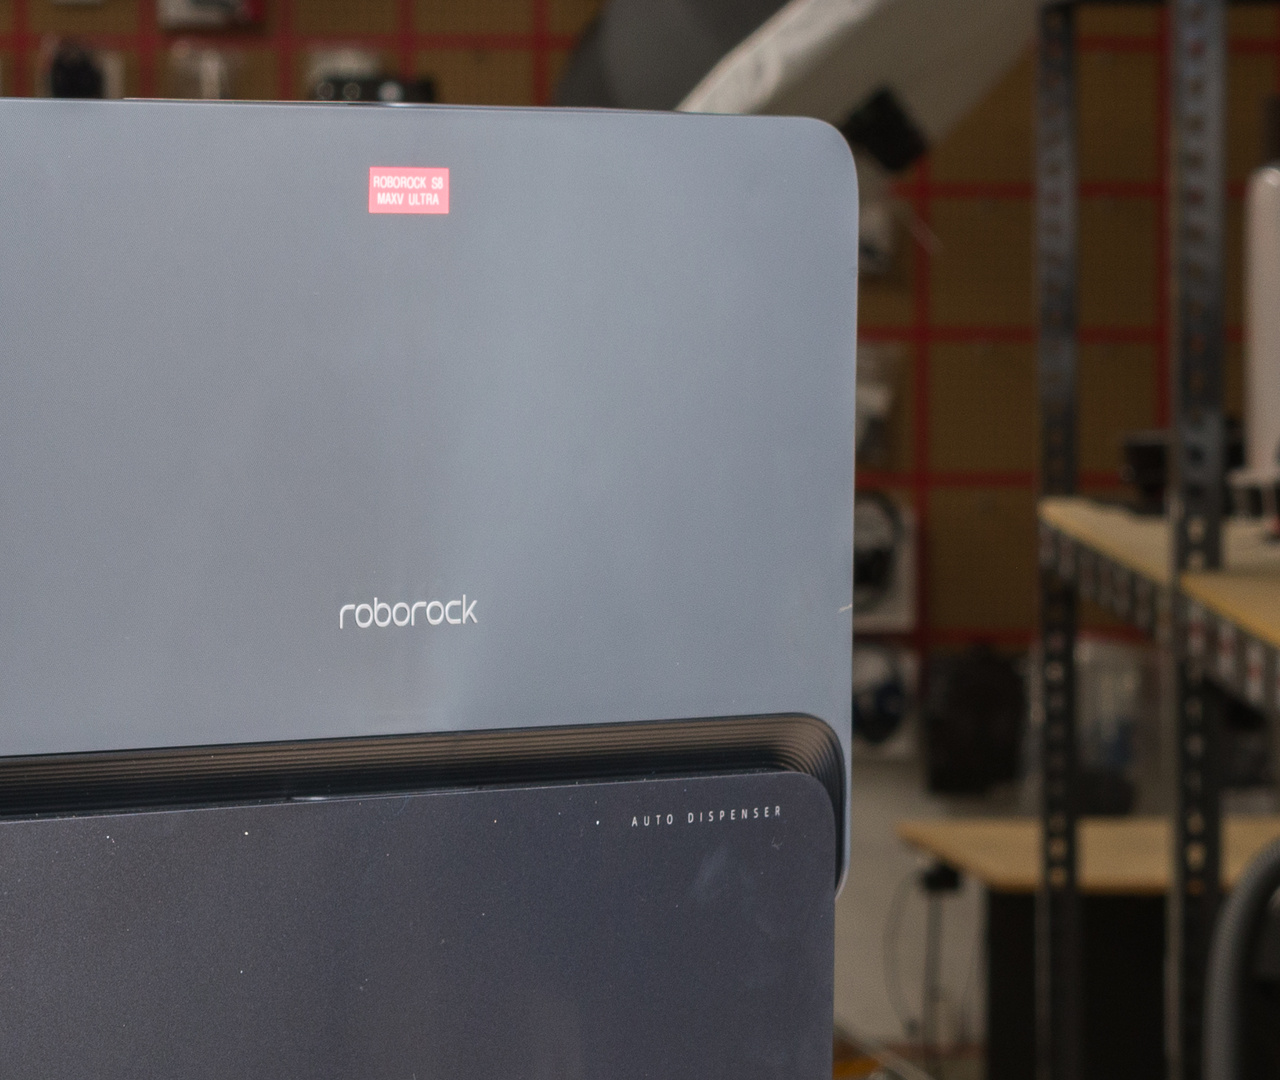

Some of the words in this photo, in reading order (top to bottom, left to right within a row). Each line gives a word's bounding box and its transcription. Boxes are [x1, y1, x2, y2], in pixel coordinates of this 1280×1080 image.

[373, 175, 426, 188] ROBOROCK
[431, 176, 443, 189] S8
[377, 192, 404, 205] MAXV
[408, 193, 439, 206] ULTRA
[339, 594, 478, 629] roborock
[631, 814, 673, 827] AUTO
[687, 805, 781, 823] DISPENSER
